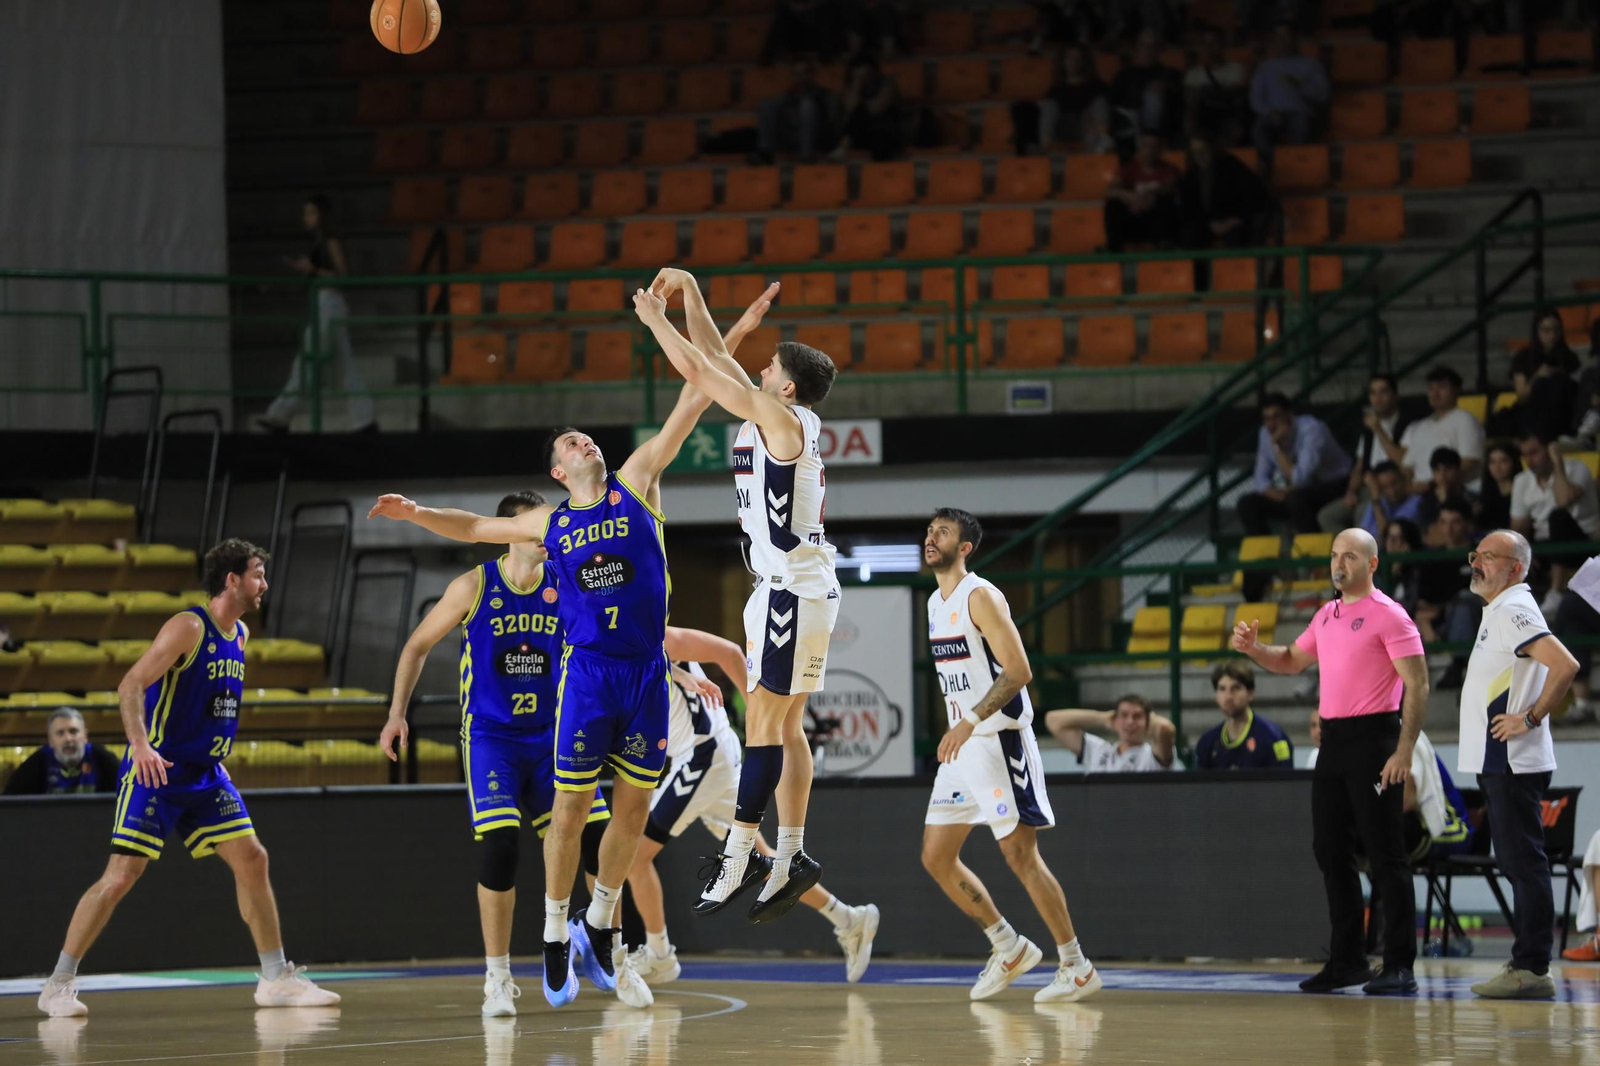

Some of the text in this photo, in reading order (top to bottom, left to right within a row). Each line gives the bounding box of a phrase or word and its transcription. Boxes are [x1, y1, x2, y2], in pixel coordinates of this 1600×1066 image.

[559, 516, 629, 554] 32005
[581, 562, 624, 580] Estrella
[585, 573, 624, 589] Galicia
[490, 613, 559, 636] 32005
[604, 606, 619, 629] 7
[504, 653, 544, 664] Estrella
[506, 663, 542, 674] Galicia
[207, 659, 245, 681] 32005
[511, 692, 537, 715] 23
[209, 736, 231, 757] 24
